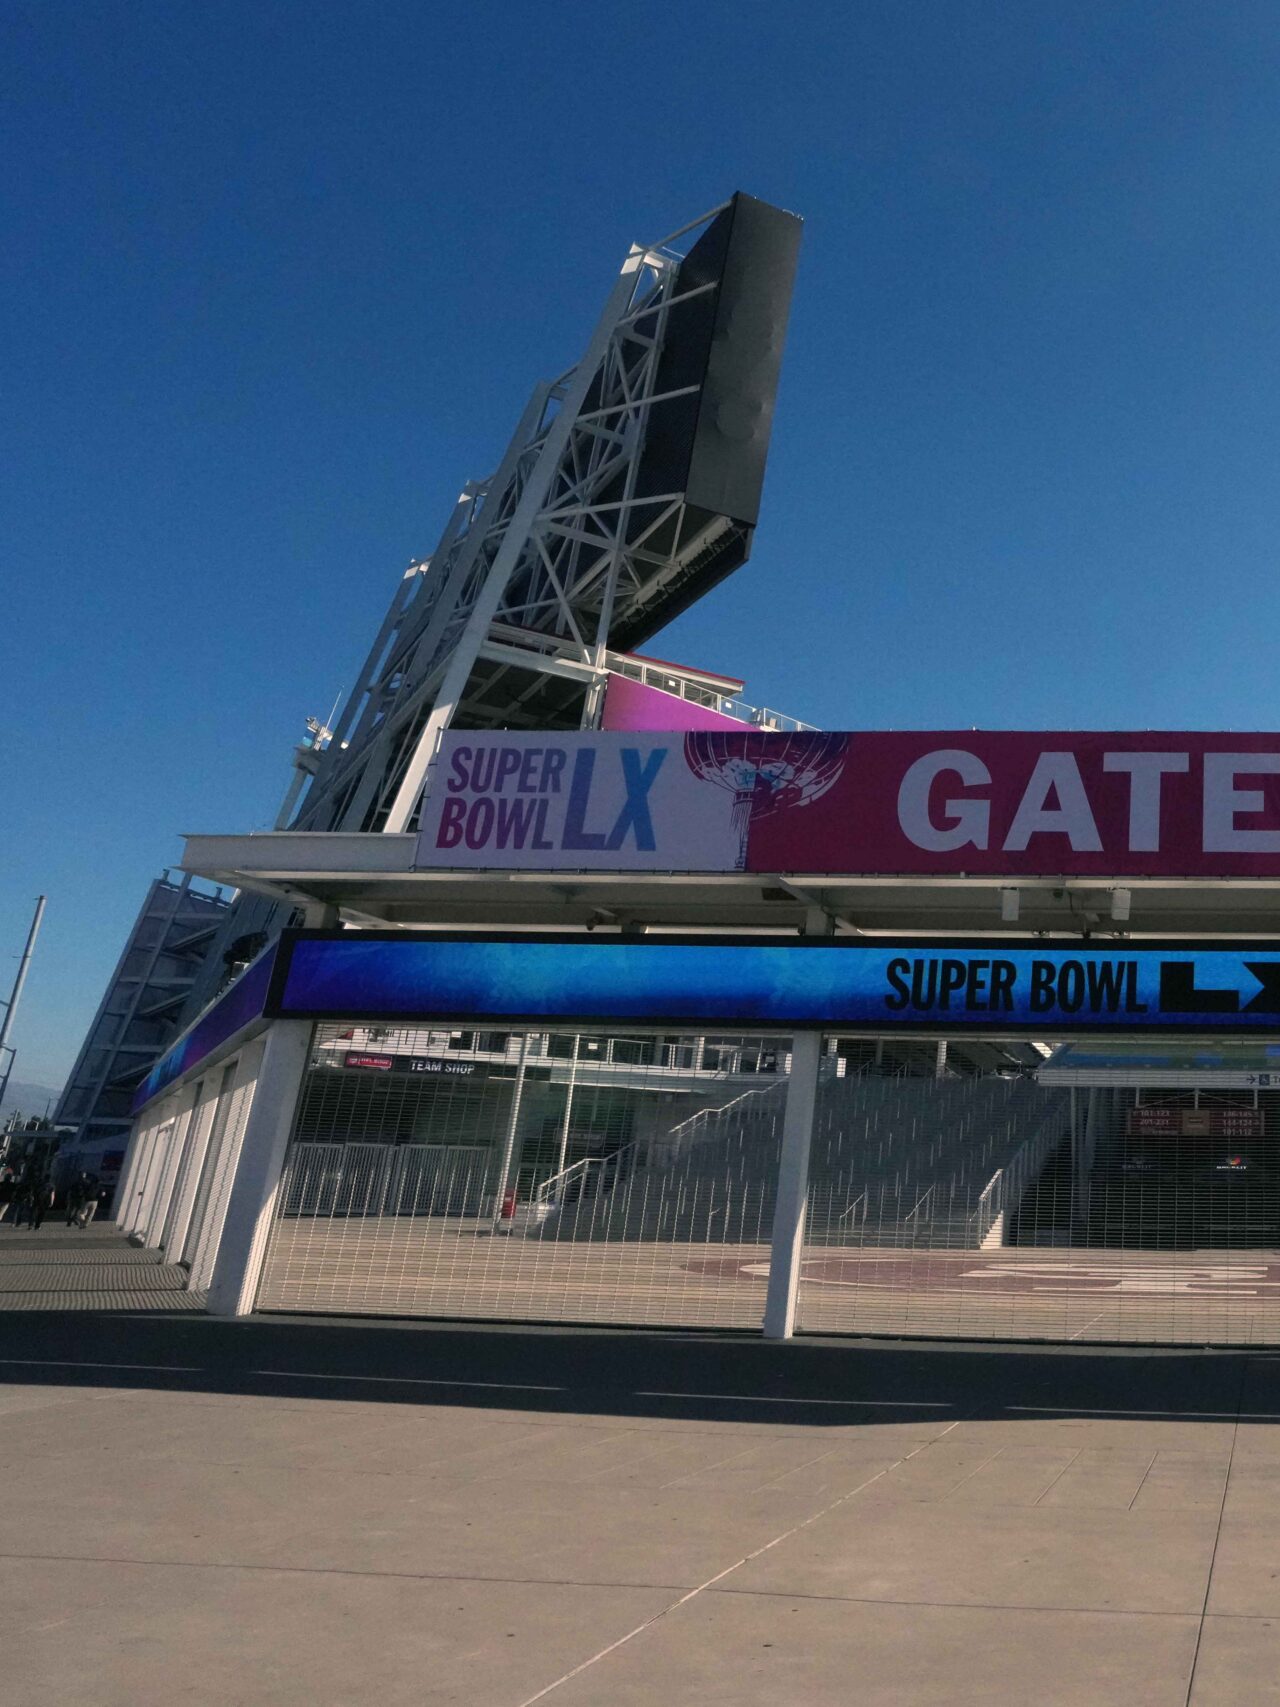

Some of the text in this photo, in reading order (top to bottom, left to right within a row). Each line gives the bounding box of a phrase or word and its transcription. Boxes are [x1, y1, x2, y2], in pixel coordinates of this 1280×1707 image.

[446, 746, 567, 794] SUPER
[435, 796, 554, 851] BOWL
[560, 747, 668, 852] LX
[884, 957, 1018, 1013] SUPER
[1028, 959, 1148, 1014] BOWL
[411, 1060, 475, 1075] TEAM SHOP
